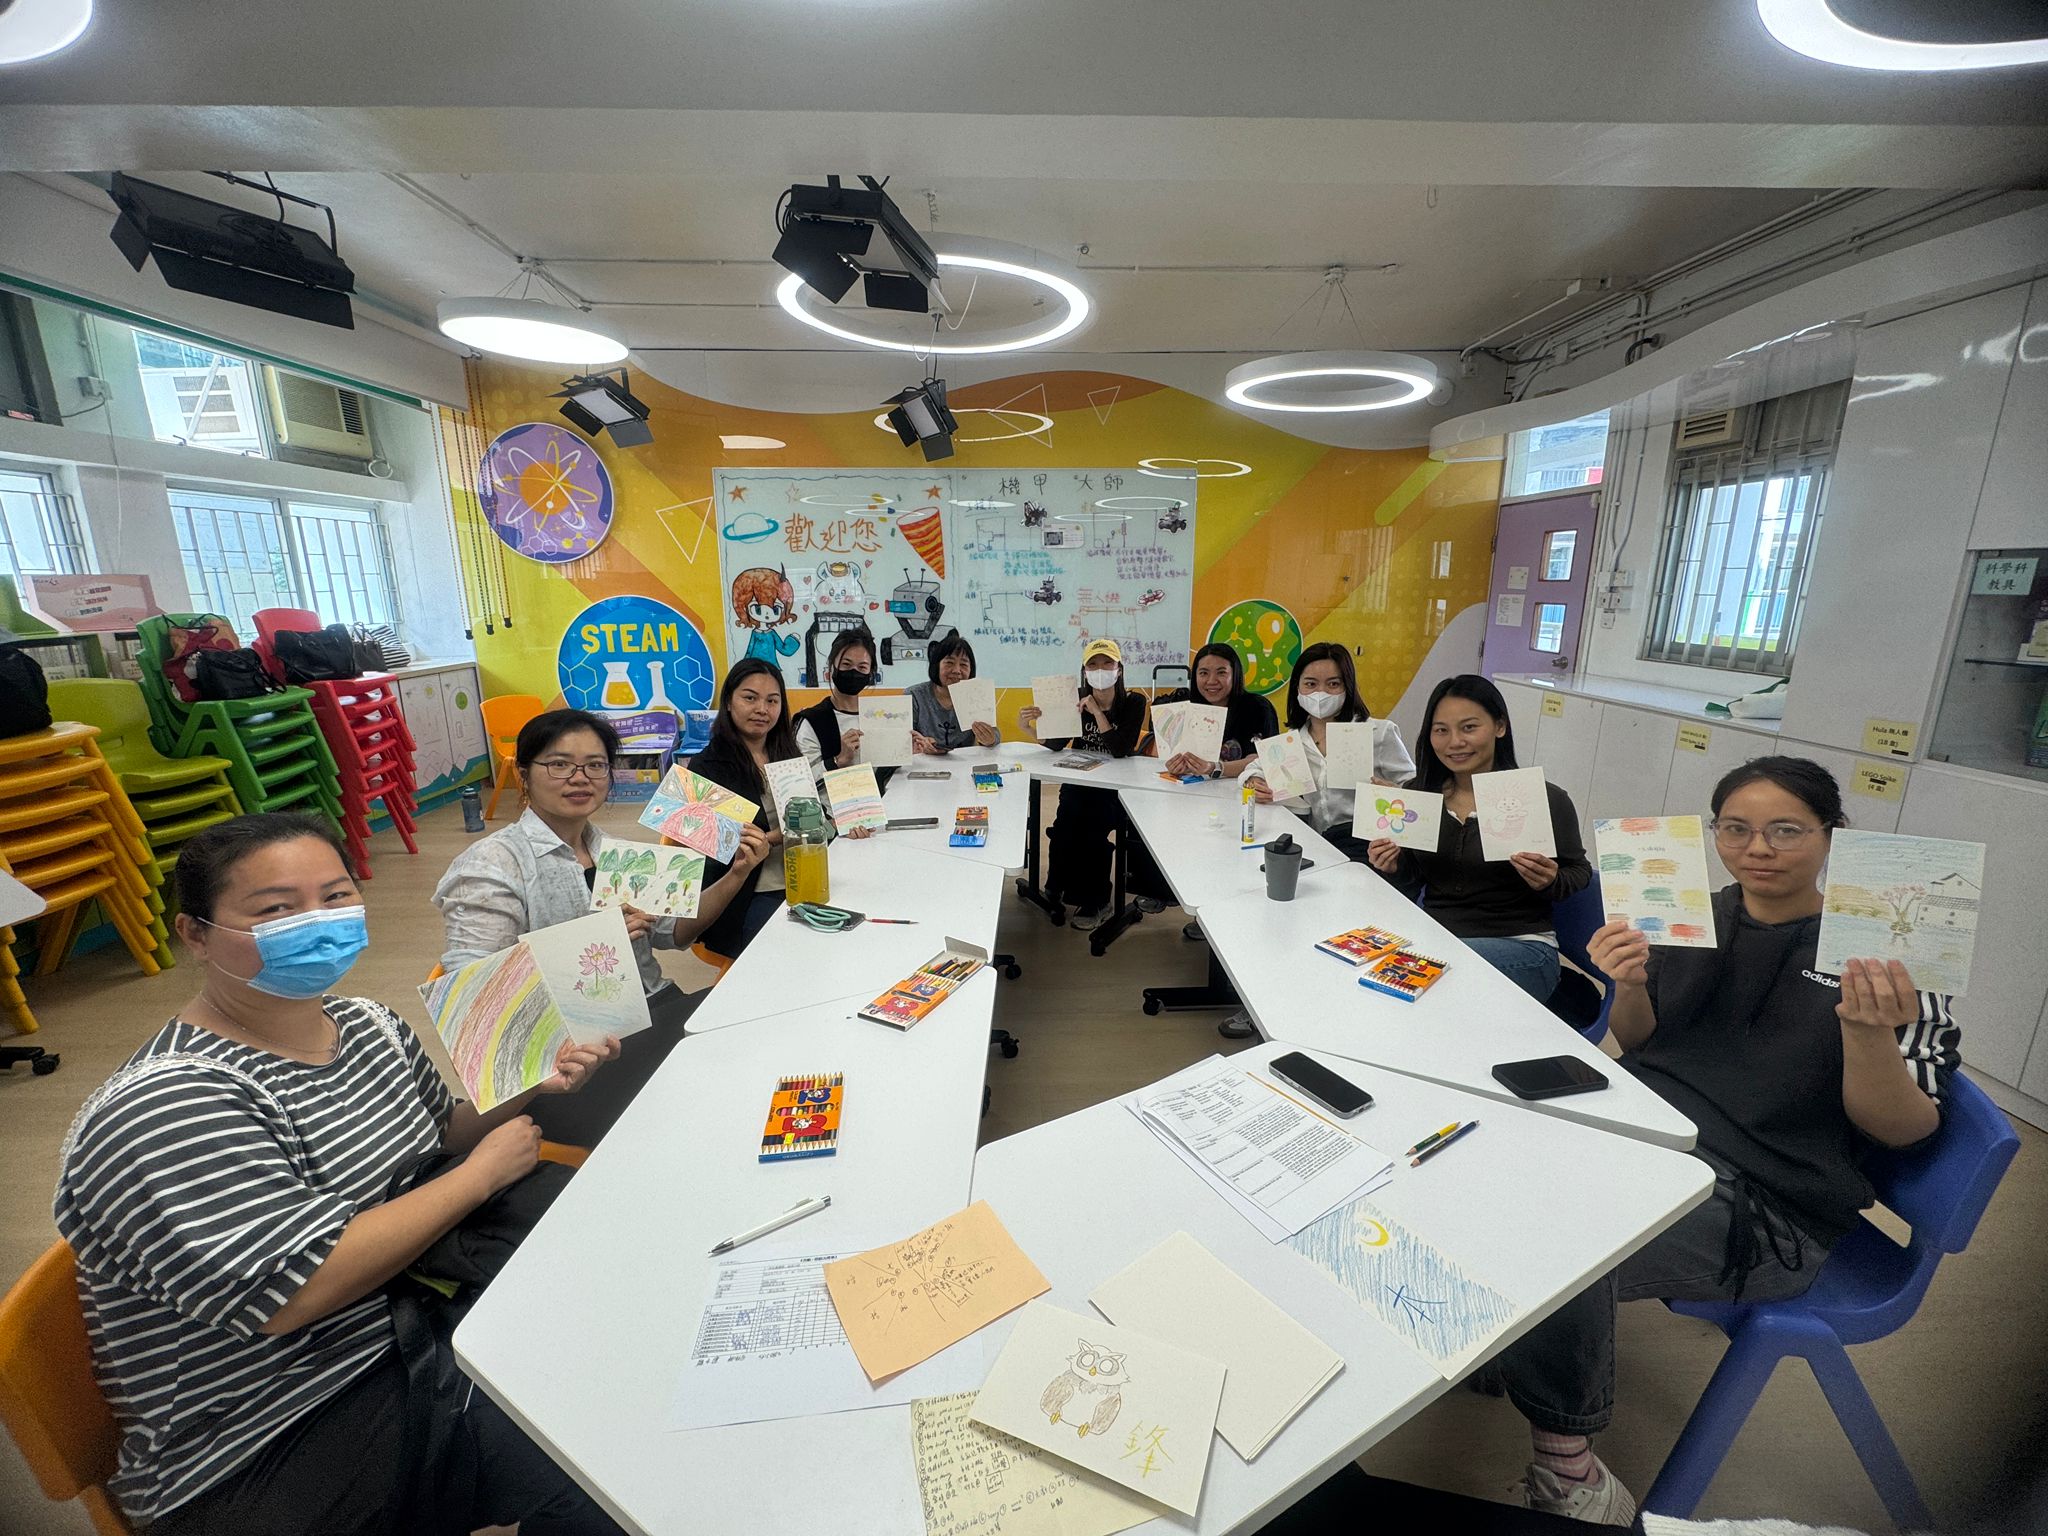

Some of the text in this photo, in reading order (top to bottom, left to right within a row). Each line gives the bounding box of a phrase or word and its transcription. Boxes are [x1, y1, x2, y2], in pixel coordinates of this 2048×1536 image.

[785, 512, 882, 553] 歡迎您
[1985, 562, 2028, 575] 科學科
[1987, 579, 2016, 590] 教具
[580, 622, 679, 654] STEAM
[1889, 728, 1909, 737] 無人機
[1861, 770, 1879, 779] LEGO
[1801, 969, 1841, 988] adidas
